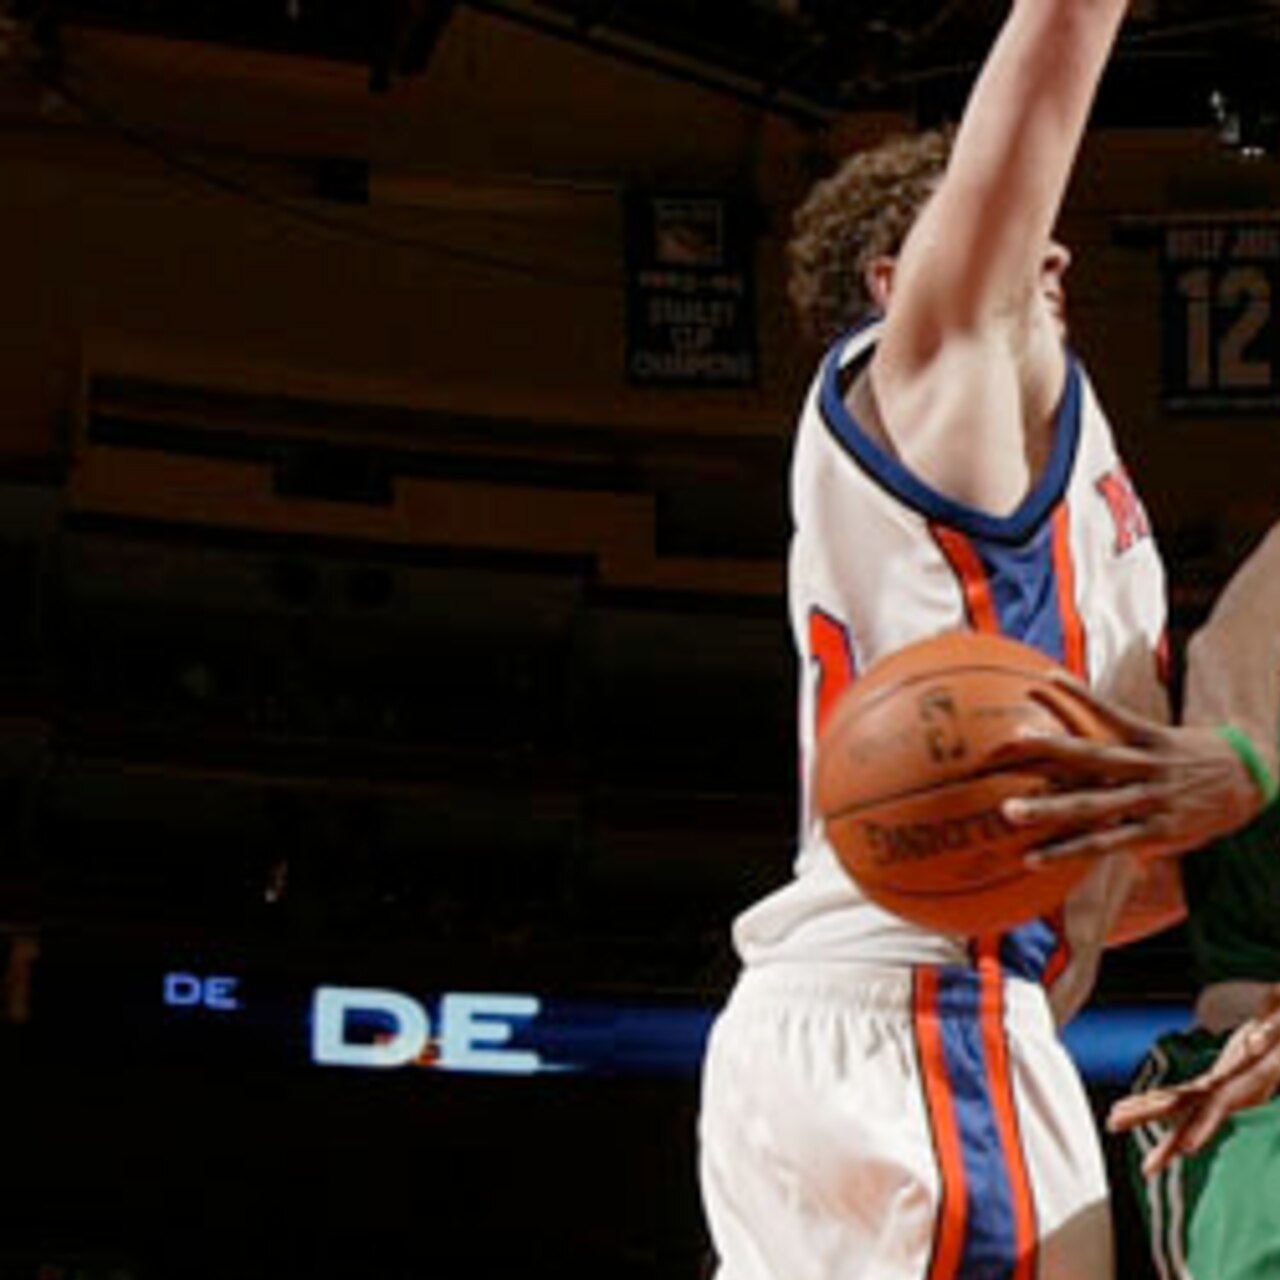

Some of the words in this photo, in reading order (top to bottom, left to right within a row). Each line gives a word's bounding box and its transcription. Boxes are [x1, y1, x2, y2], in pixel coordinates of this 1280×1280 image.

[1177, 266, 1271, 388] 12
[163, 972, 240, 1009] DE
[312, 985, 542, 1074] DE
